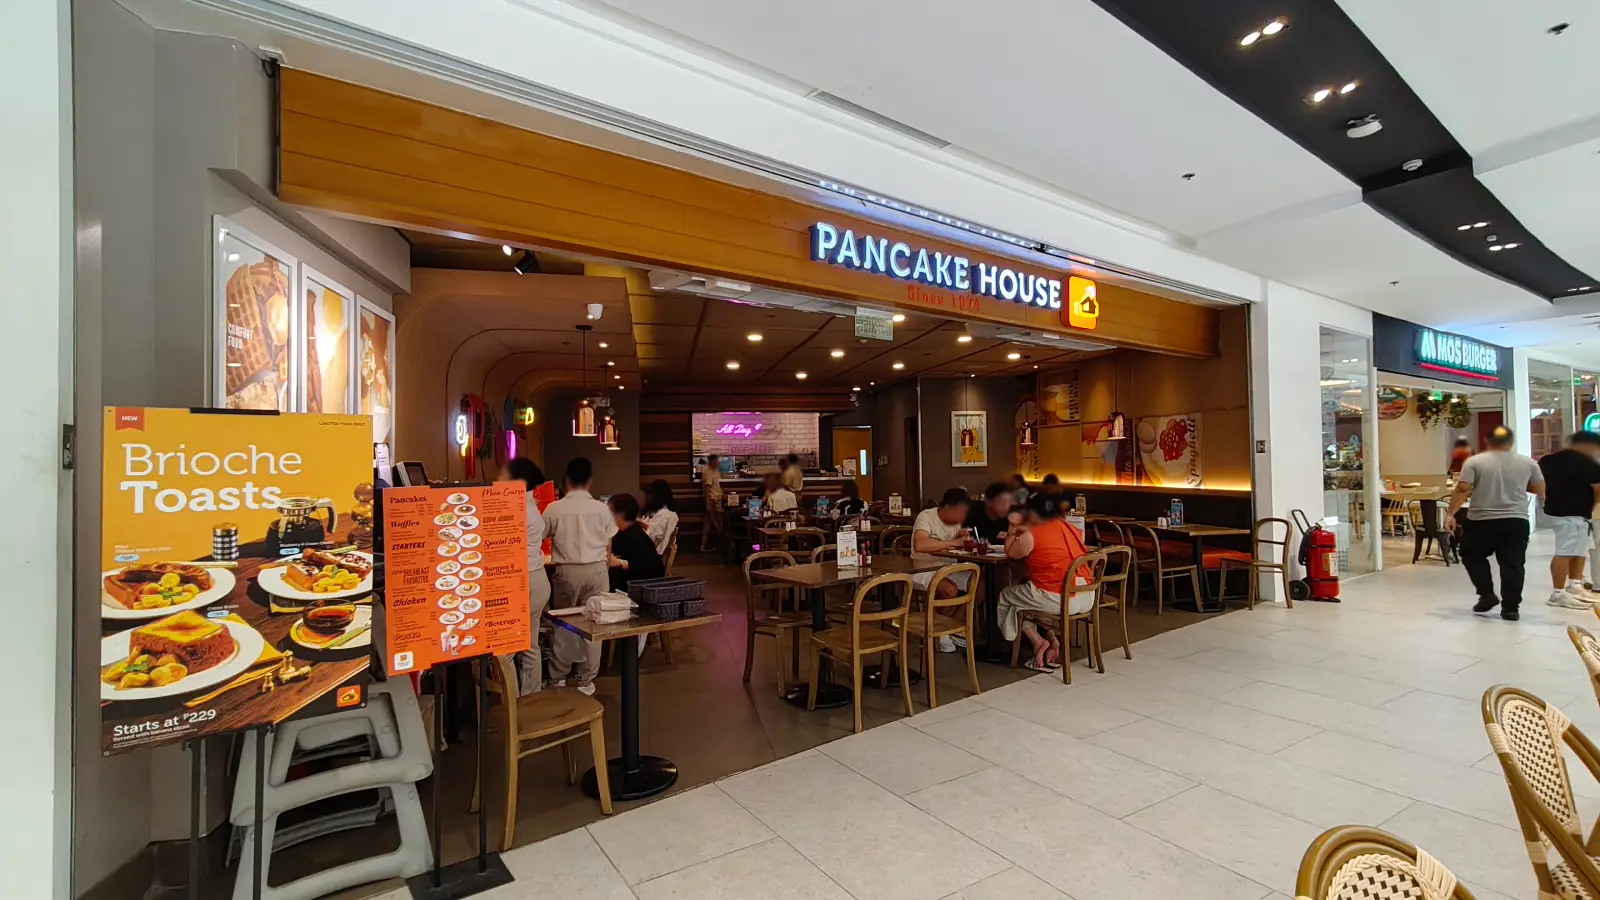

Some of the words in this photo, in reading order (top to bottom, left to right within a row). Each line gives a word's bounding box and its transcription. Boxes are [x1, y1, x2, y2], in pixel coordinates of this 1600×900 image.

[813, 221, 970, 291] PANCAKE
[978, 261, 1062, 310] HOUSE
[907, 284, 944, 306] Since
[228, 323, 254, 341] COMFORT
[228, 336, 243, 349] FOOD
[1437, 333, 1462, 365] MOS
[1462, 340, 1498, 372] BURGER
[716, 424, 736, 434] All
[734, 423, 753, 438] Day
[1186, 416, 1199, 487] Spaghetti
[121, 443, 302, 477] Brioche
[120, 480, 282, 514] Toasts
[390, 496, 428, 504] Pancakes
[391, 520, 420, 529] Waffles
[391, 541, 426, 551] STARTERS
[483, 537, 507, 548] Special
[393, 597, 427, 607] Chicken
[485, 618, 521, 628] Beverages
[113, 721, 159, 736] Starts
[164, 716, 179, 727] at
